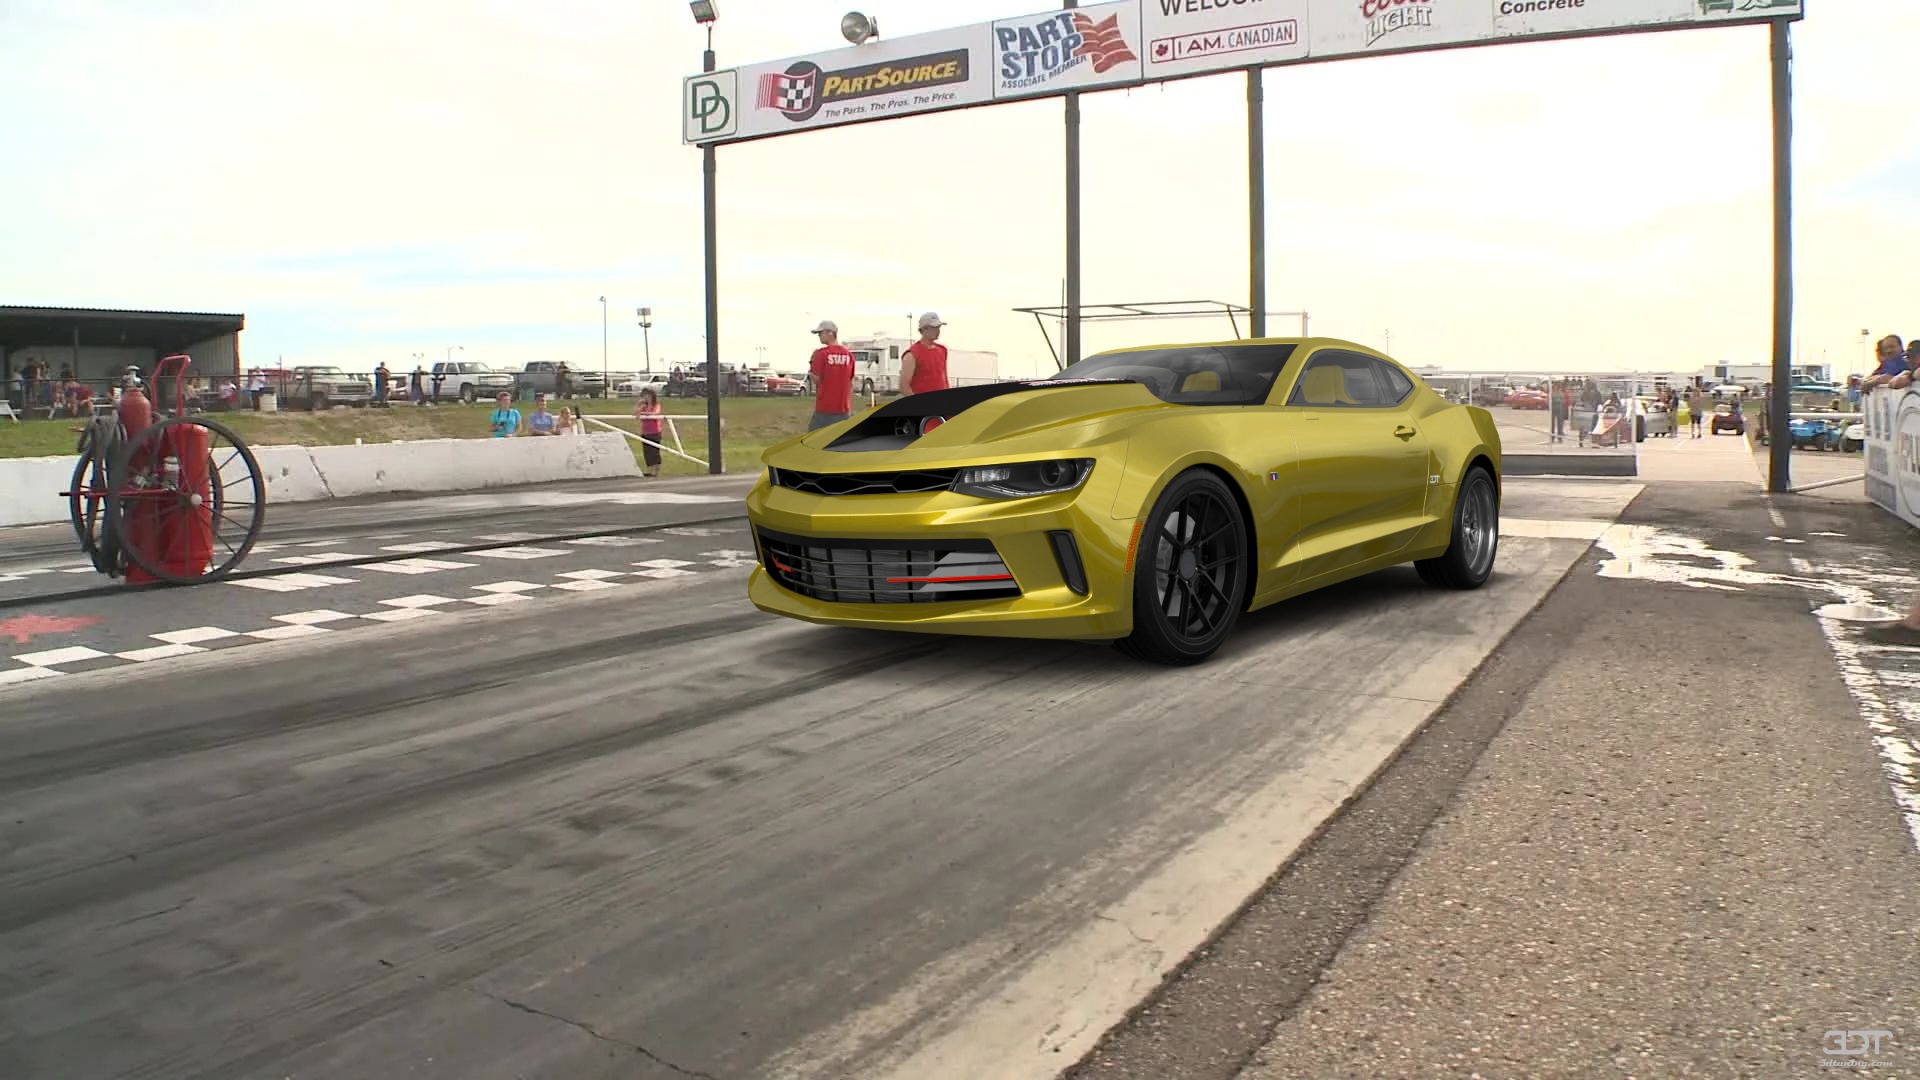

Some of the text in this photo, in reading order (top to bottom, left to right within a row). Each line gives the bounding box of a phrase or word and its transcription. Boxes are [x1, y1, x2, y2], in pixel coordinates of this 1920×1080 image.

[1500, 0, 1584, 14] Concrete
[996, 13, 1076, 51] PART
[1178, 41, 1182, 55] I
[1228, 24, 1293, 48] CANADIAN
[1366, 6, 1432, 47] LIGHT
[1001, 34, 1081, 79] STOP
[1001, 55, 1087, 89] ASSOCIATE MEMBER
[825, 110, 841, 118] The
[870, 102, 886, 111] The
[913, 95, 929, 104] The
